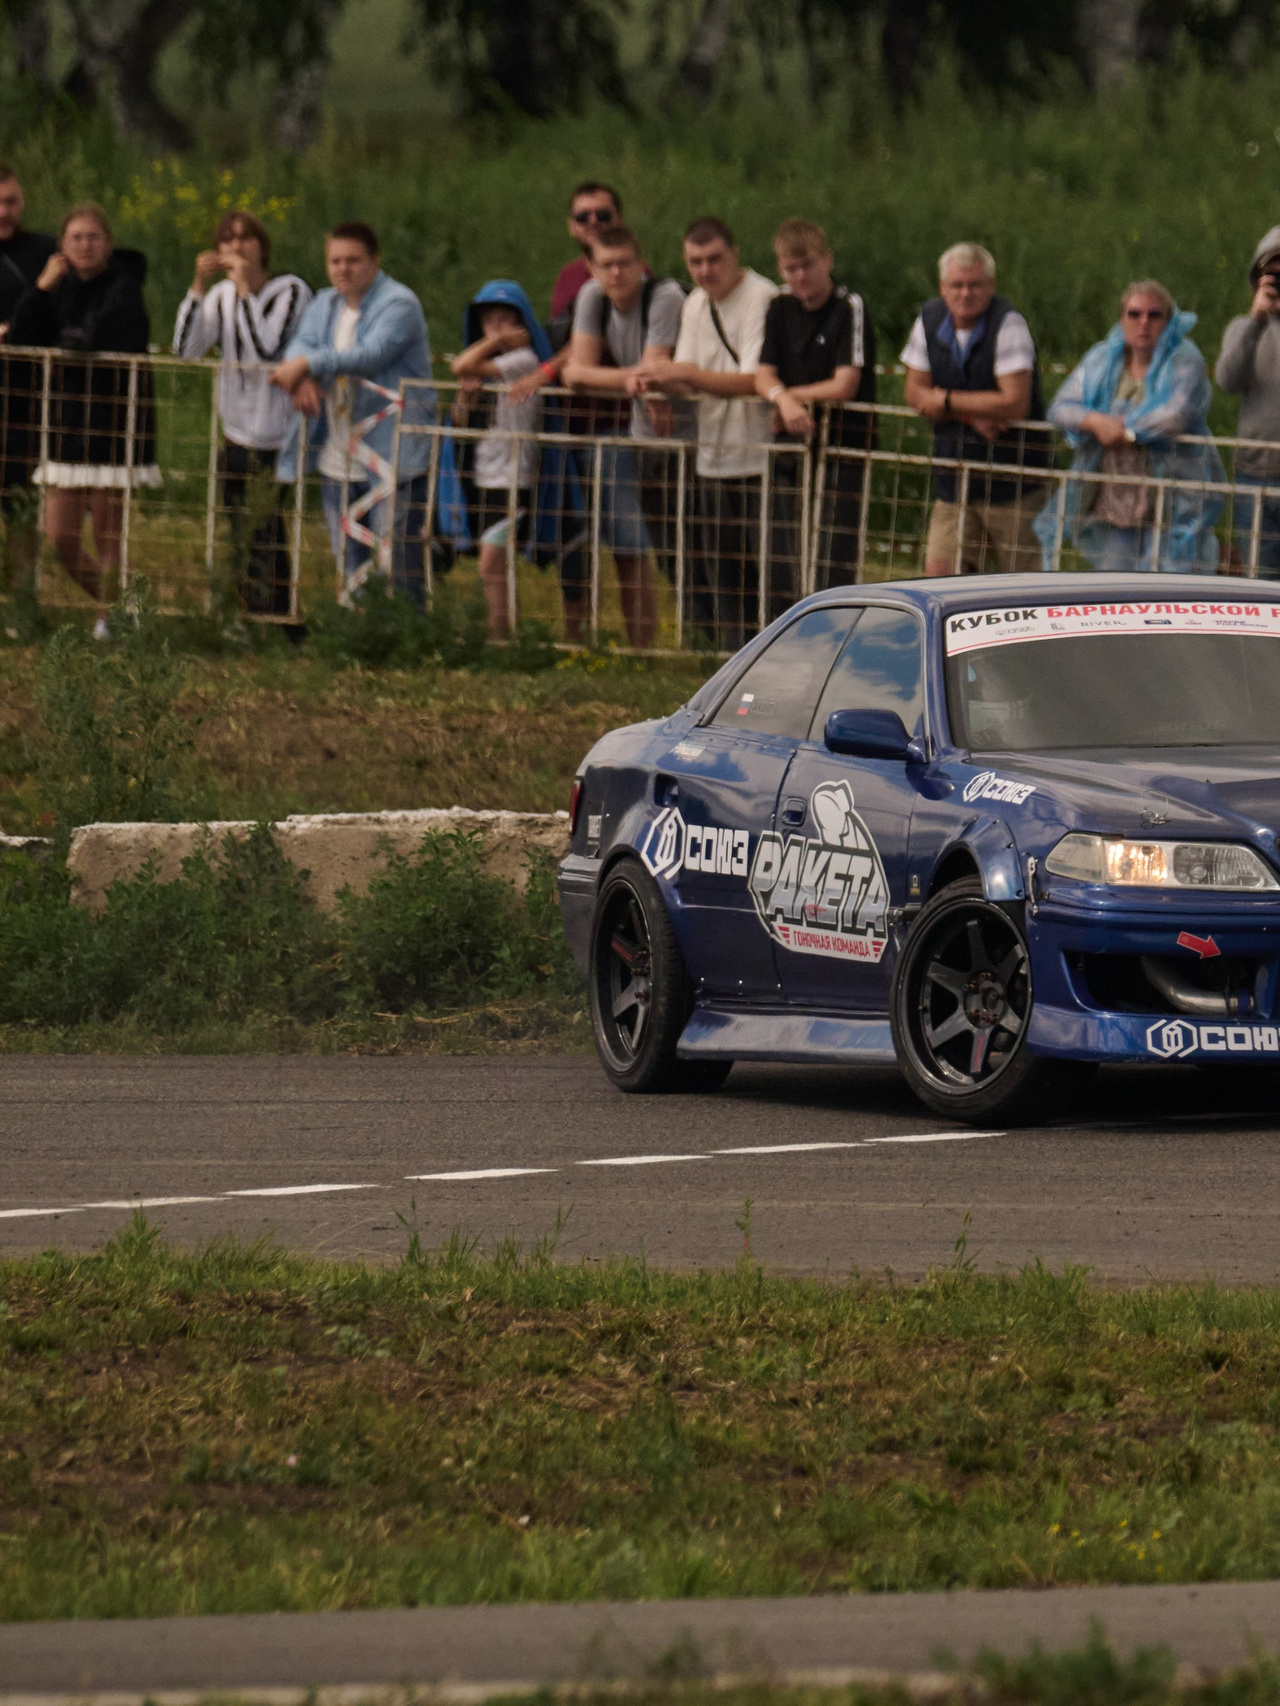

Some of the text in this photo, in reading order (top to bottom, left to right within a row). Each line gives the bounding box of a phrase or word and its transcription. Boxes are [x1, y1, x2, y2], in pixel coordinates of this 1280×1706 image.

[950, 608, 1039, 633] КУБОК
[1047, 603, 1261, 619] БАРНАУЛЬСКОЙ
[982, 778, 1037, 805] СОЮЗ
[686, 824, 750, 877] СОЮЗ
[750, 836, 889, 936] РАКЕТА
[793, 930, 871, 957] ГОНОЧНАЯ КОМАНДА
